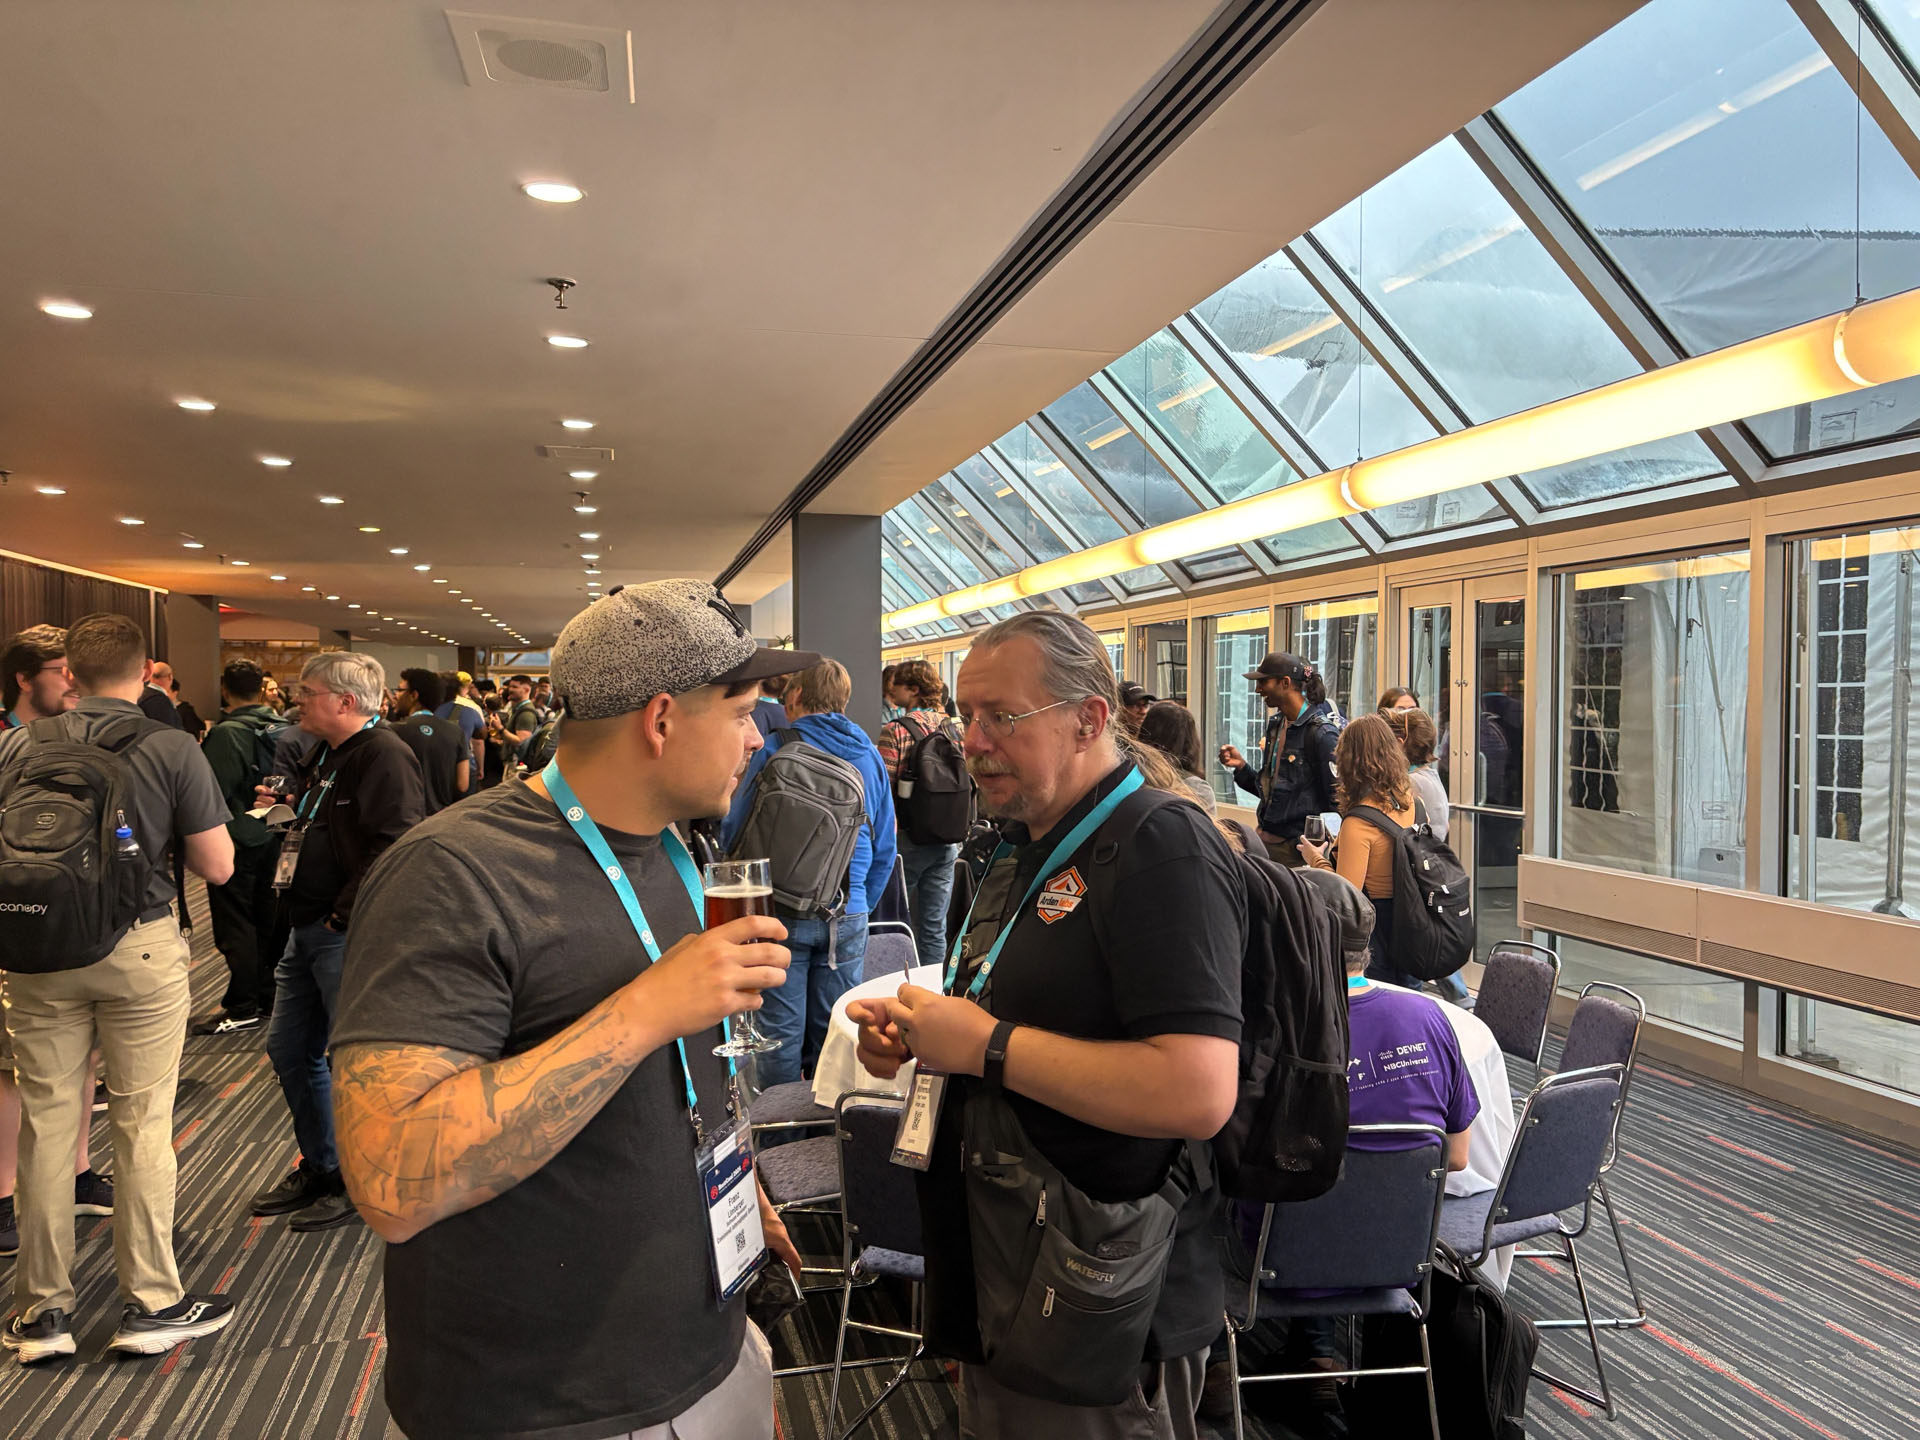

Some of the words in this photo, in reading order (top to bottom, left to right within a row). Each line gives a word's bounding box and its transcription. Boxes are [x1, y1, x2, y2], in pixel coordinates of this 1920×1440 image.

[1040, 896, 1058, 905] Arden
[0, 902, 48, 915] canopy
[1396, 1042, 1426, 1055] DEVNET
[1383, 1056, 1429, 1072] NBCUniversal
[1066, 1257, 1116, 1284] WATERFLY
